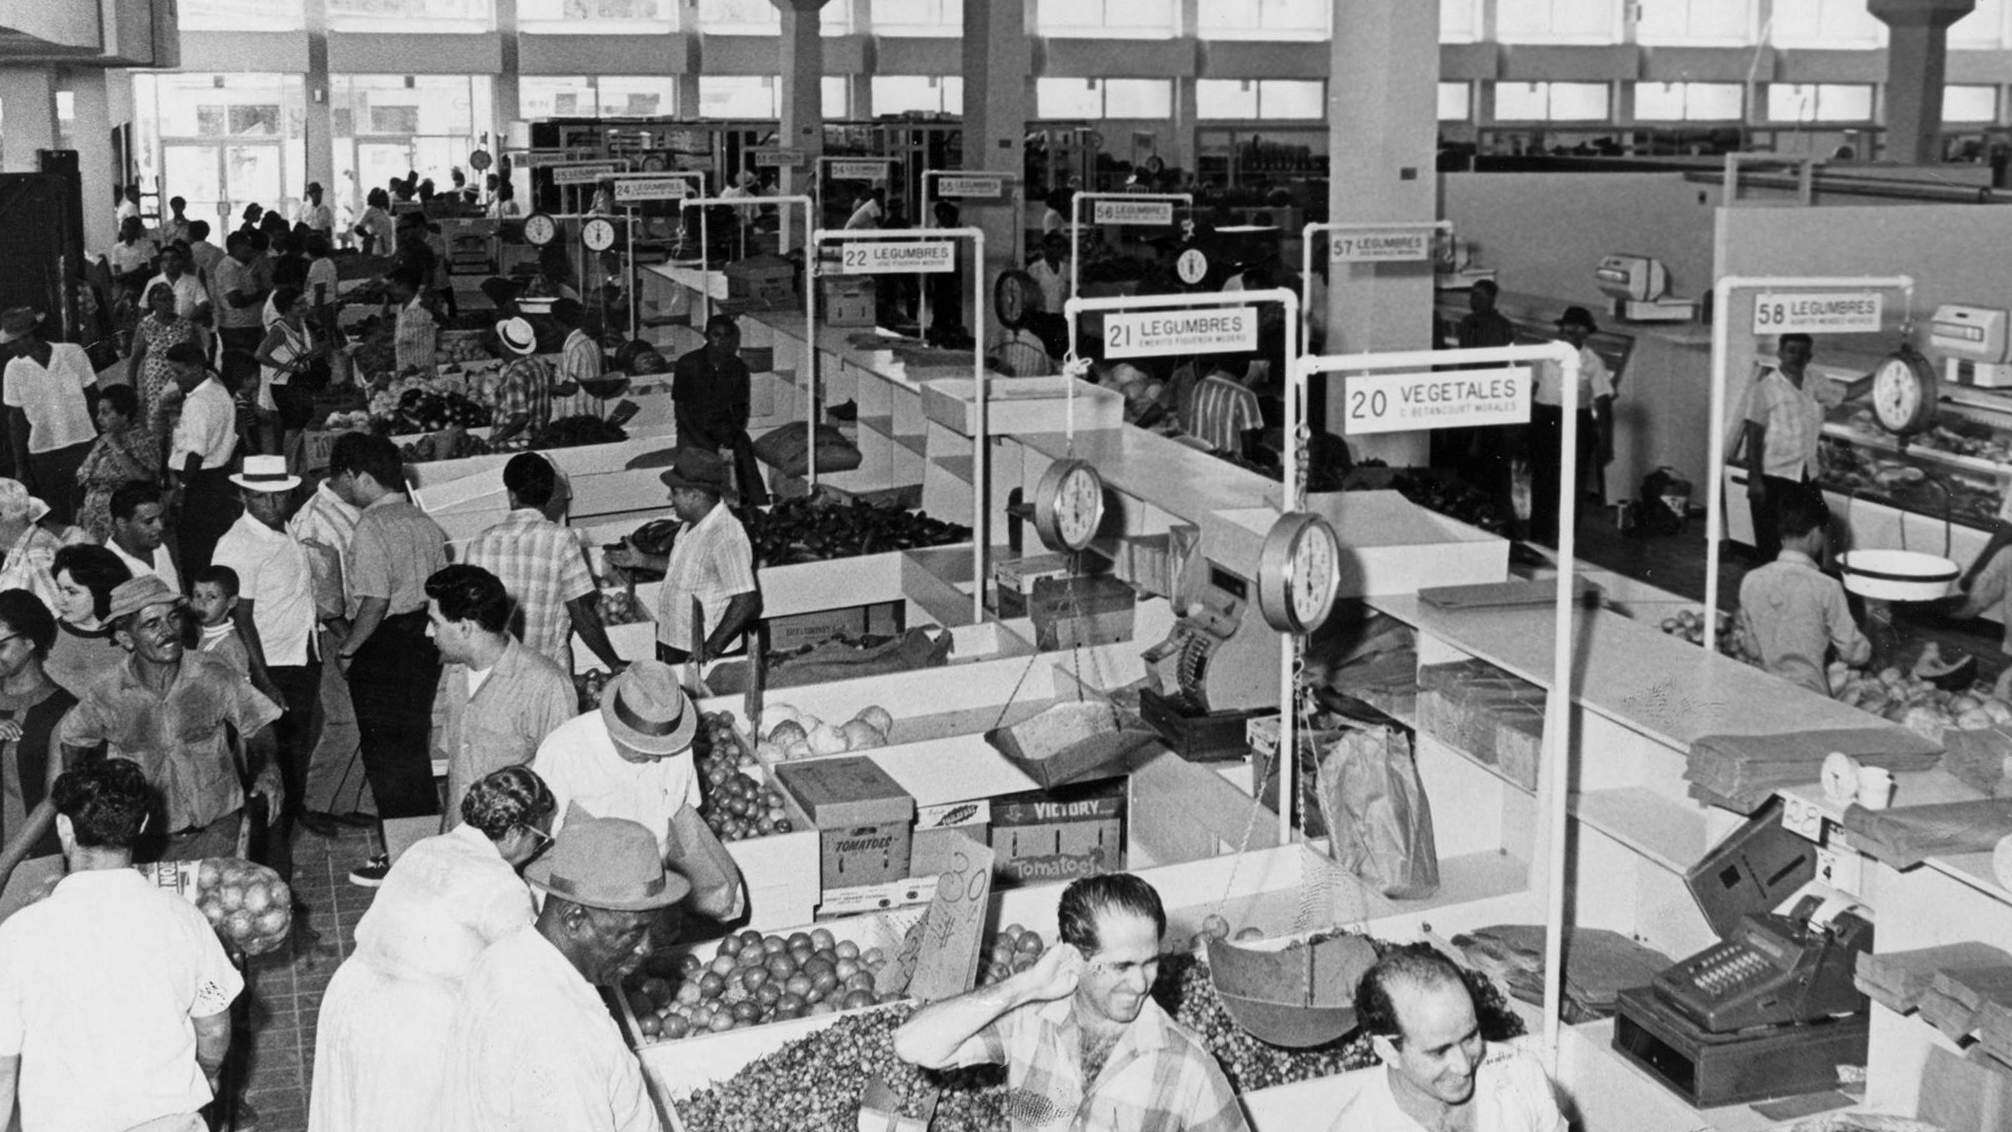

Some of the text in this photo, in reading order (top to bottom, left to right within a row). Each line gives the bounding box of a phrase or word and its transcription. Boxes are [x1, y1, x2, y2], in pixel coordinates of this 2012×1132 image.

[616, 184, 630, 196] 24
[1333, 239, 1353, 256] 57
[1356, 237, 1422, 249] LEGUMBRES
[845, 247, 949, 267] 22 LEGUMBRES
[1758, 303, 1785, 325] 58
[1791, 300, 1875, 315] LEGUMBRES
[1110, 316, 1243, 348] 21 LEGUMBRES
[1351, 379, 1517, 419] 20 VEGETALES
[1474, 400, 1517, 413] MORALES
[1034, 801, 1099, 819] VICTORY
[836, 836, 892, 852] TOMATOES
[1015, 855, 1096, 878] Tomatoes
